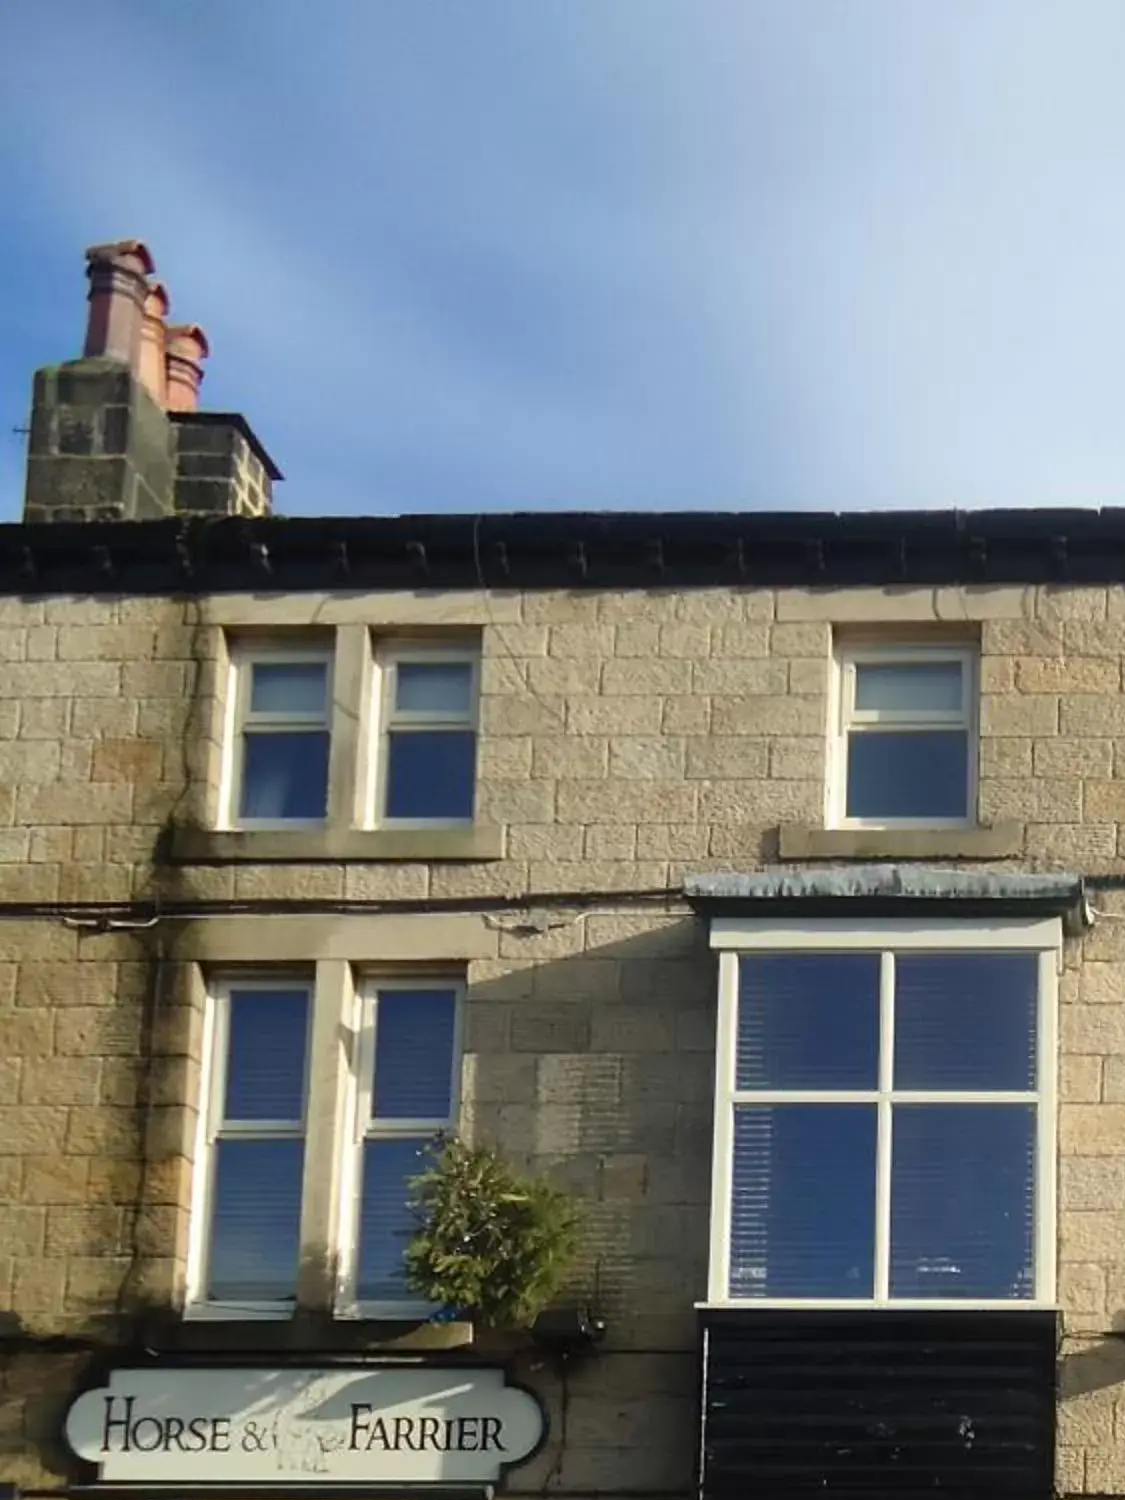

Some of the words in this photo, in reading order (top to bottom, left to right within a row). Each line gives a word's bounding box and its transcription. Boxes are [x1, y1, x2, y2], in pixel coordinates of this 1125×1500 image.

[102, 1396, 231, 1452] HORSE
[241, 1421, 268, 1452] &
[348, 1403, 507, 1452] FARRIER
